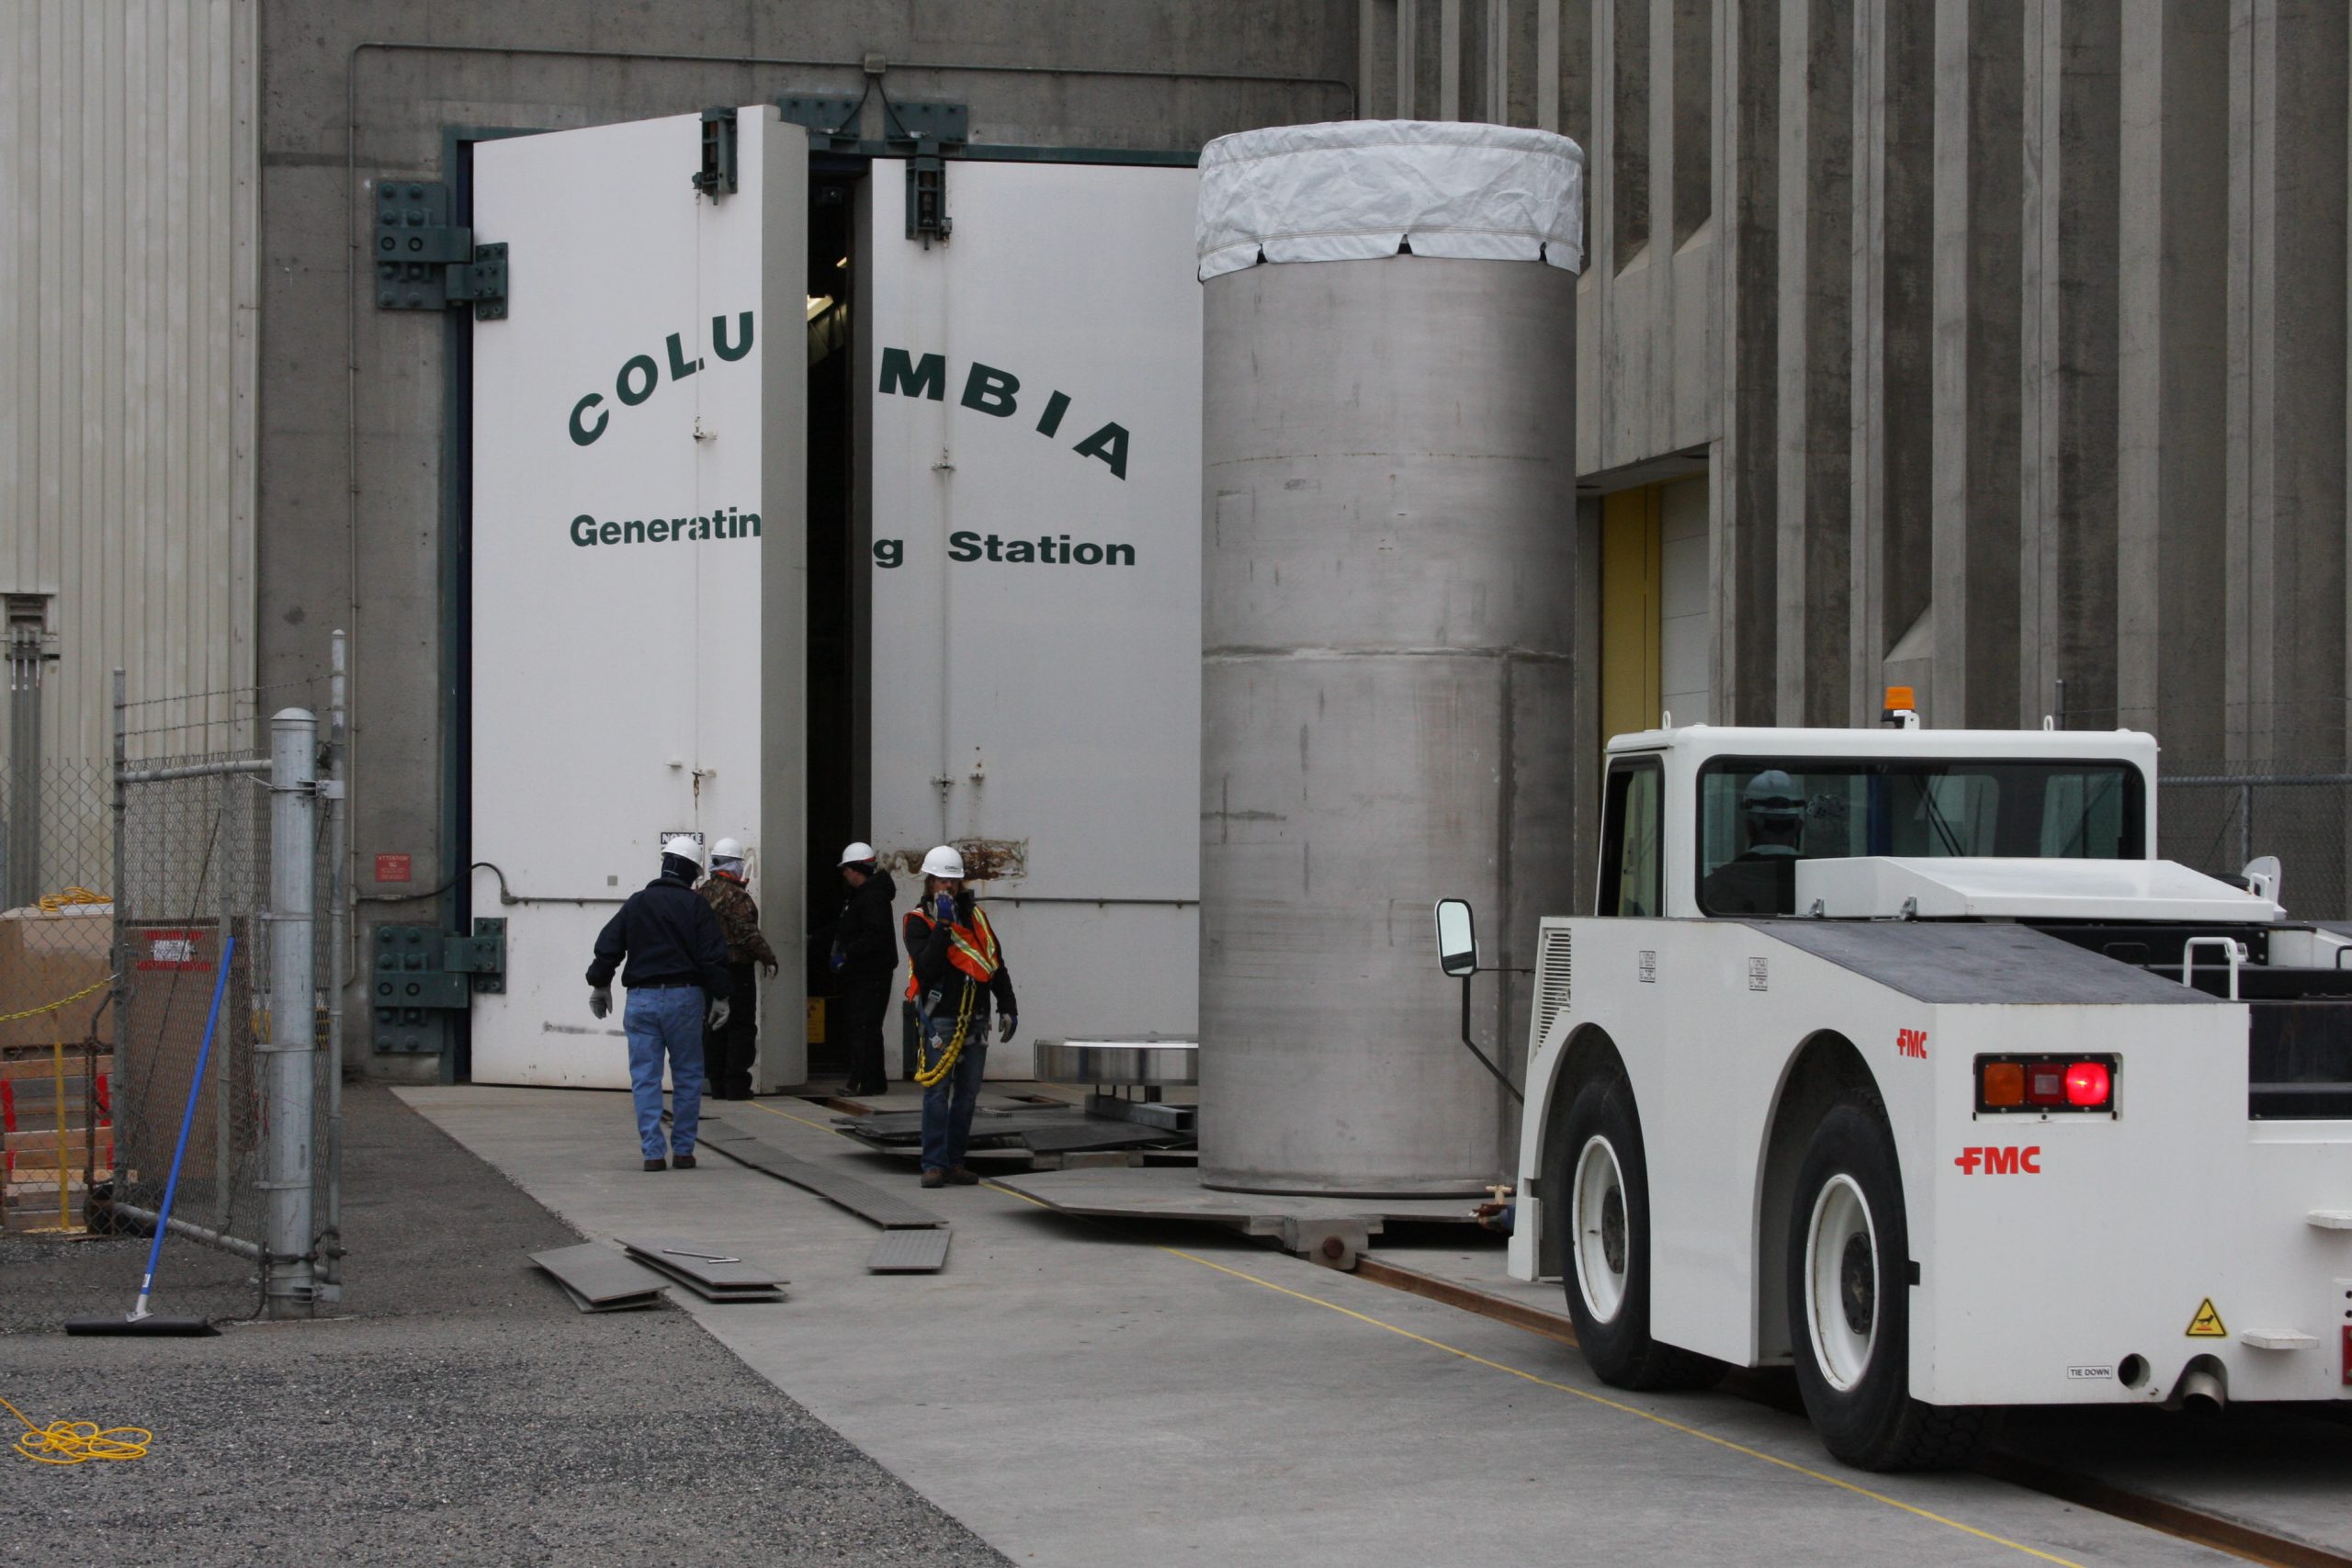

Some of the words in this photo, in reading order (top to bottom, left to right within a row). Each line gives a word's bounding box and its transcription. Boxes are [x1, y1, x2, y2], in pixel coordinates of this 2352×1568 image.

[947, 530, 1136, 567] Station
[1896, 1028, 1928, 1059] FMC
[1954, 1145, 2041, 1175] FMC
